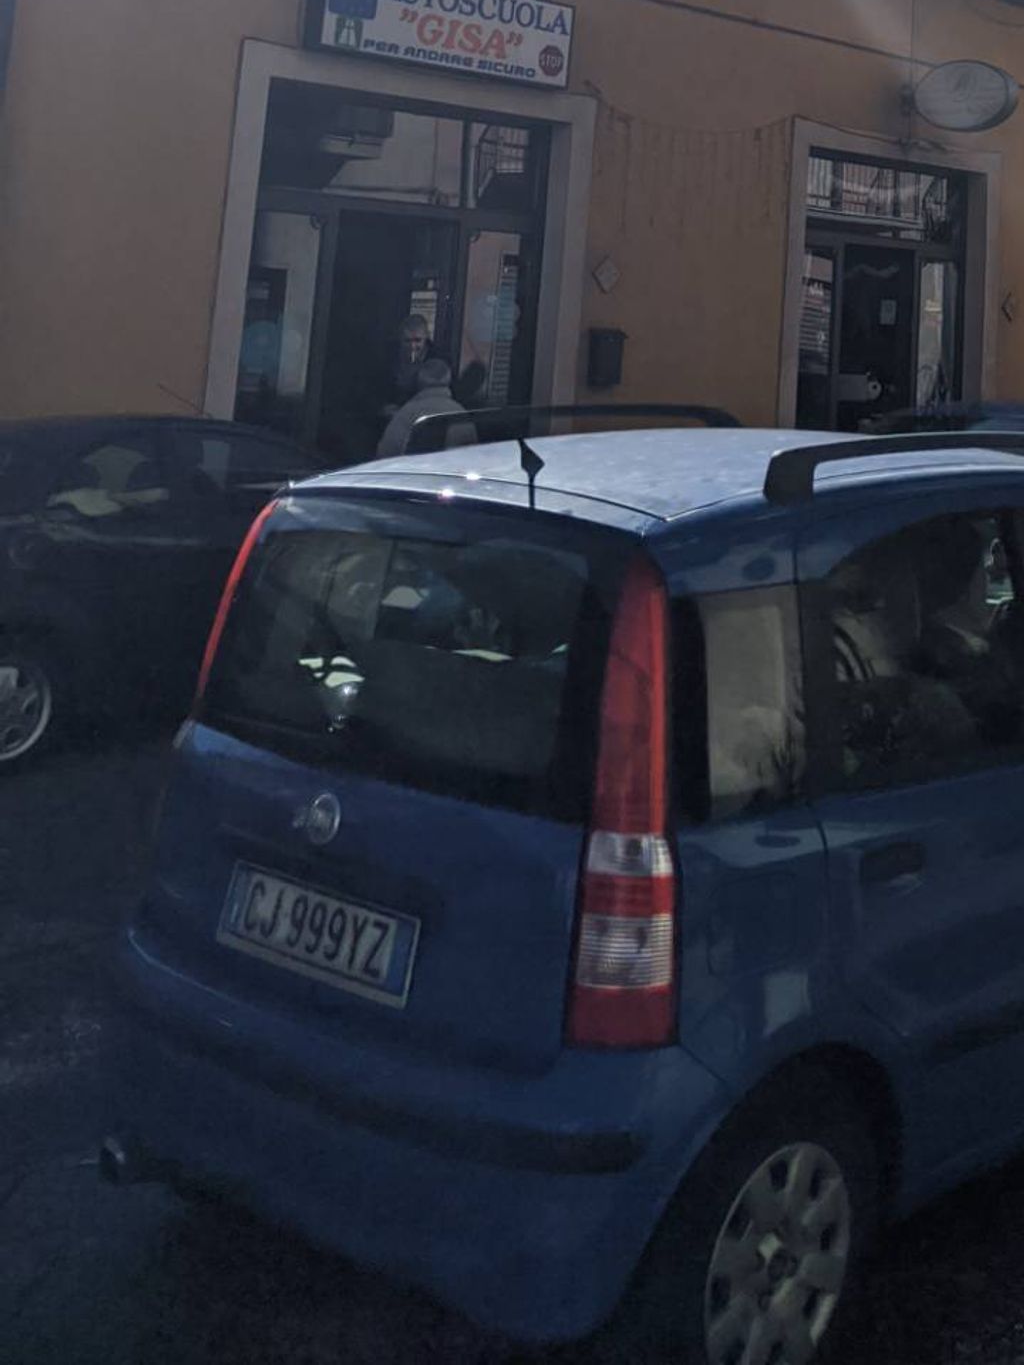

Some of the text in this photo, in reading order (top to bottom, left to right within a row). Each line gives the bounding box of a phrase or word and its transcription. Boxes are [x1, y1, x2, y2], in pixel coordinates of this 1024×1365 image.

[364, 38, 536, 78] PER ANDARE SICURO
